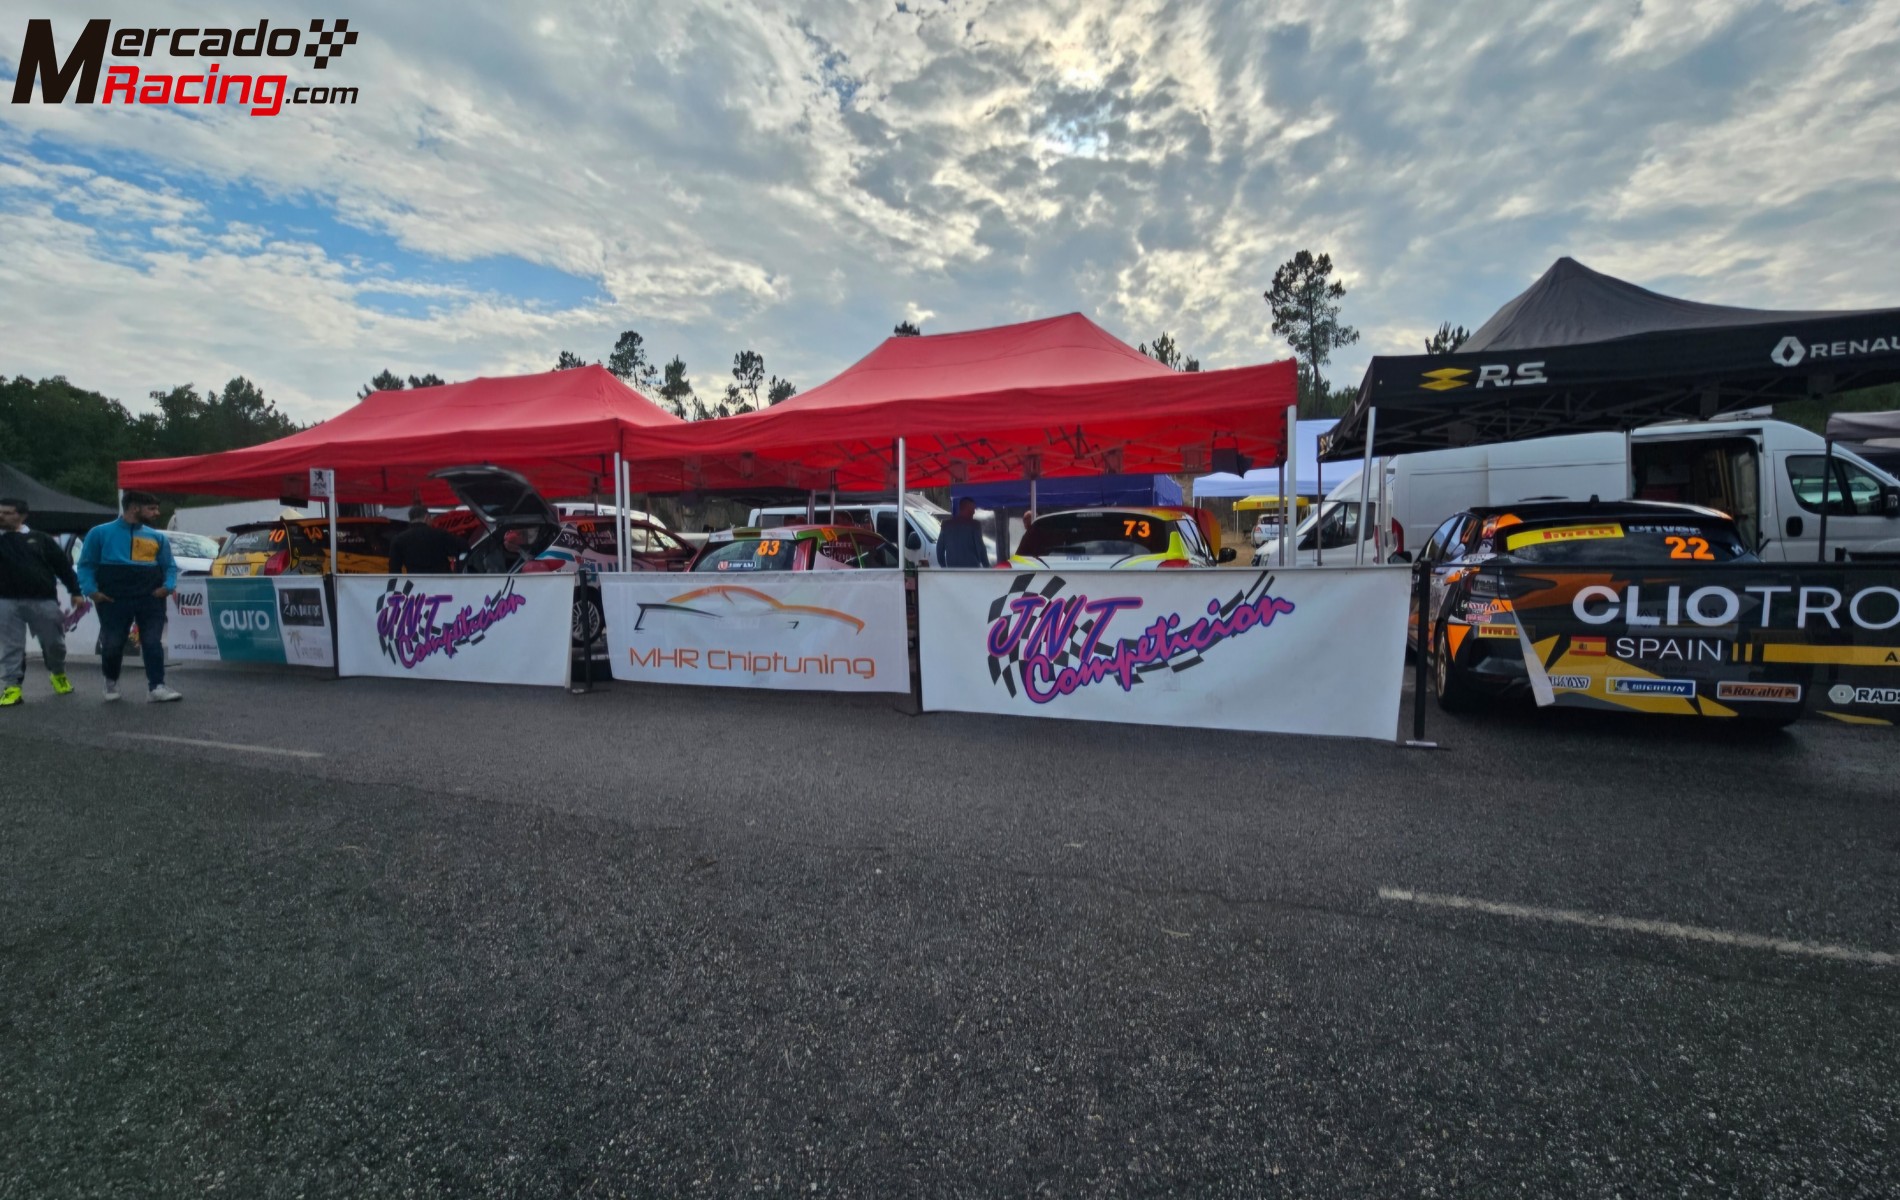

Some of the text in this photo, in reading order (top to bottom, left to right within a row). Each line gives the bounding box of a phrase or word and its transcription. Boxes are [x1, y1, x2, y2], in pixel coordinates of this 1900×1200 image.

[268, 529, 286, 543] 10
[1123, 520, 1151, 538] 73
[756, 540, 780, 556] 83
[1665, 536, 1715, 560] 22
[219, 608, 270, 631] auro
[987, 594, 1144, 663] JNT
[630, 647, 699, 669] MHR
[1616, 637, 1722, 662] SPAIN
[707, 650, 875, 679] Chiptuning
